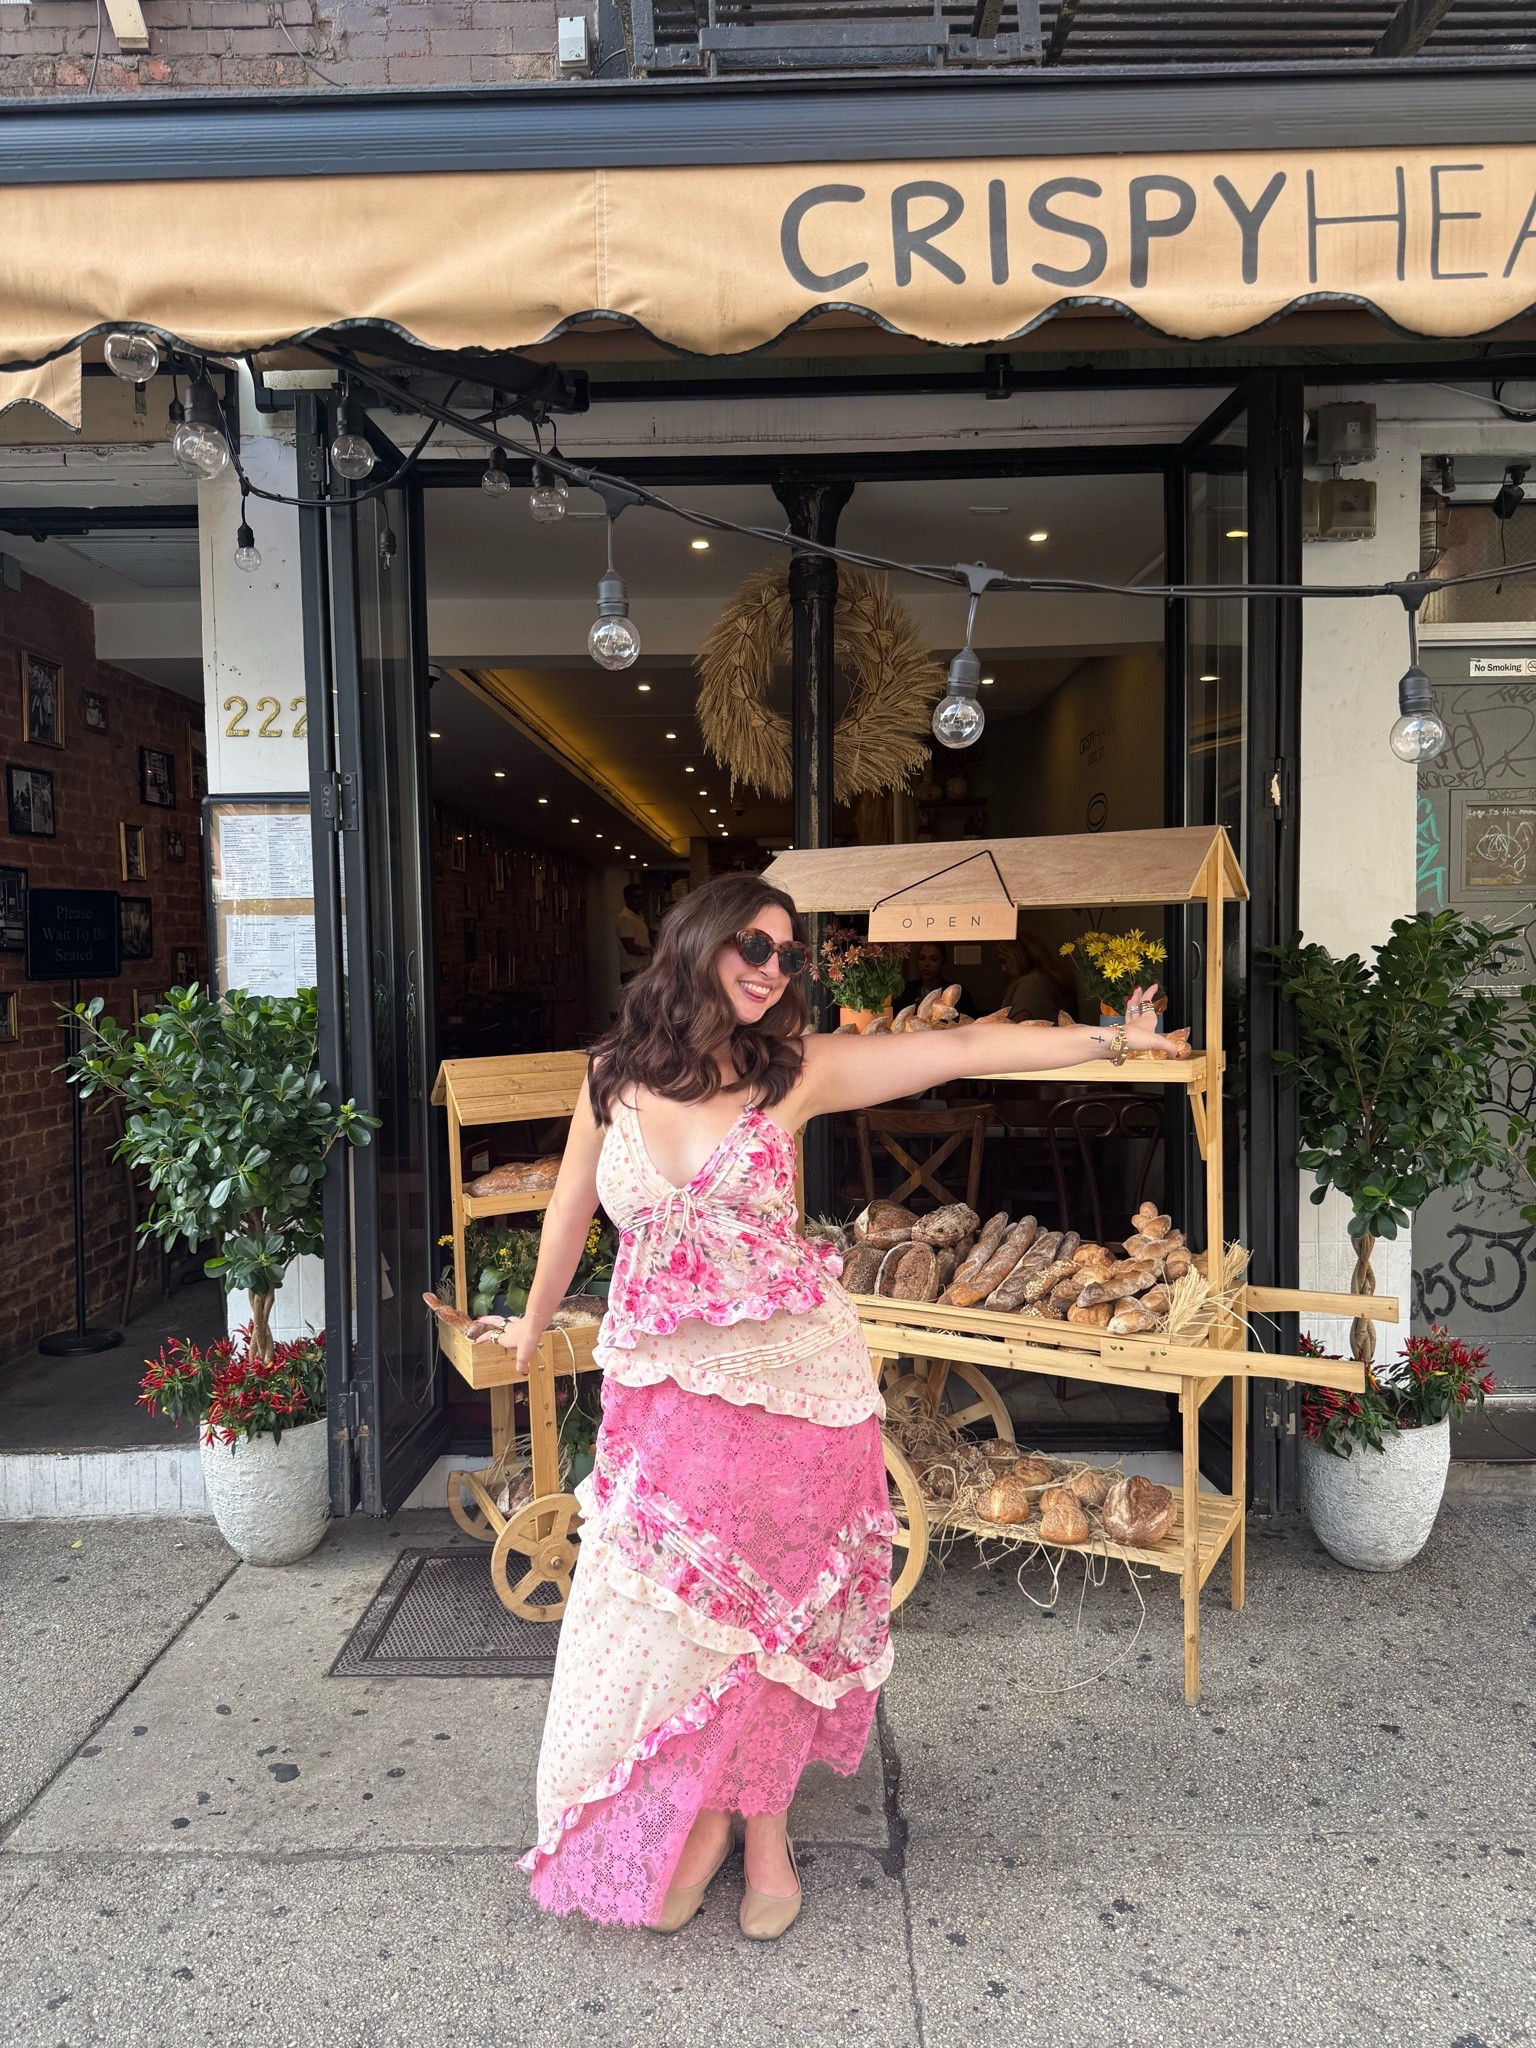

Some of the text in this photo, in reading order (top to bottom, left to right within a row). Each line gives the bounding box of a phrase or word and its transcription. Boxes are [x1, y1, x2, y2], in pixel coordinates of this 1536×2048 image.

[1474, 662, 1522, 673] No Smoking
[224, 695, 308, 738] 222
[56, 905, 93, 920] Please
[902, 916, 981, 929] OPEN
[42, 926, 108, 941] Wait To Be
[55, 947, 93, 962] Seated
